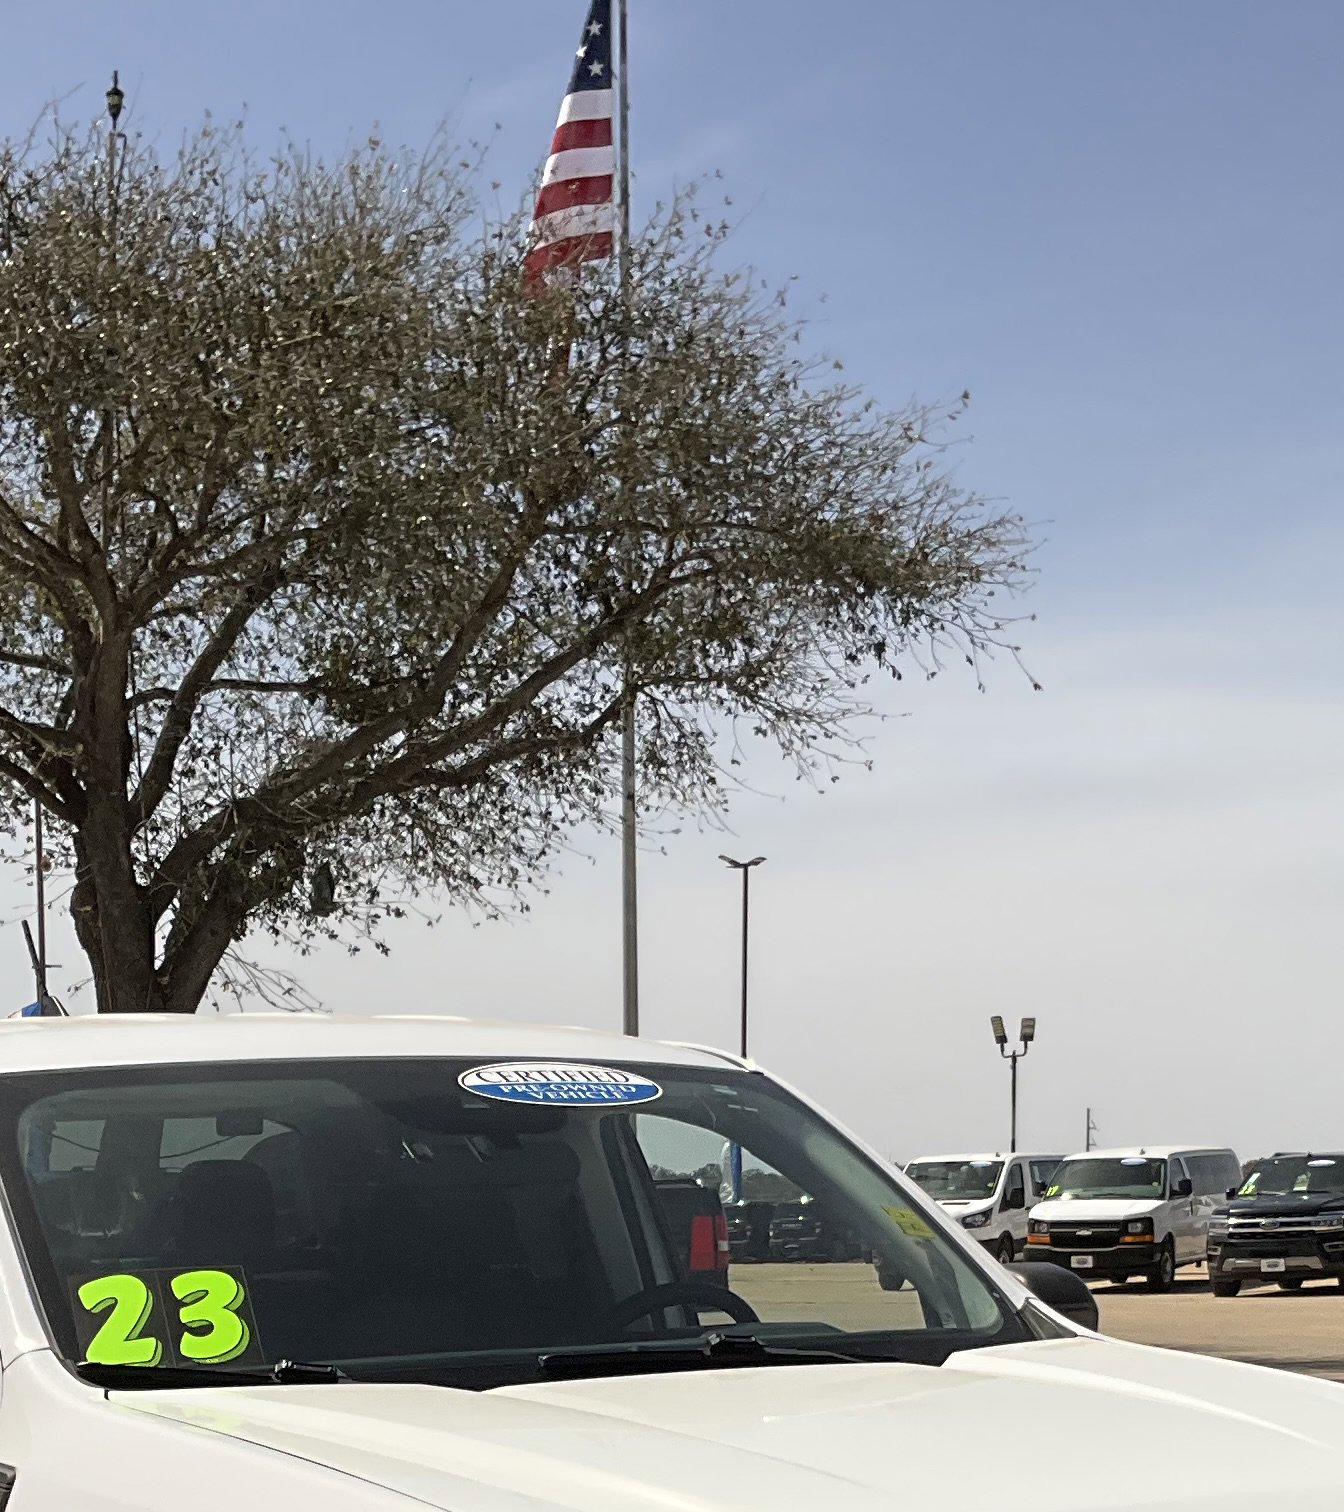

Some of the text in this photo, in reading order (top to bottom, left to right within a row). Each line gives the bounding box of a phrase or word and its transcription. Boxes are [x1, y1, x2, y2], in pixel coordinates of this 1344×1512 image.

[475, 1070, 631, 1084] CERTIFIED
[498, 1083, 636, 1093] PRE-OWNED
[528, 1091, 629, 1100] VEHICLE
[78, 1270, 251, 1368] 23
